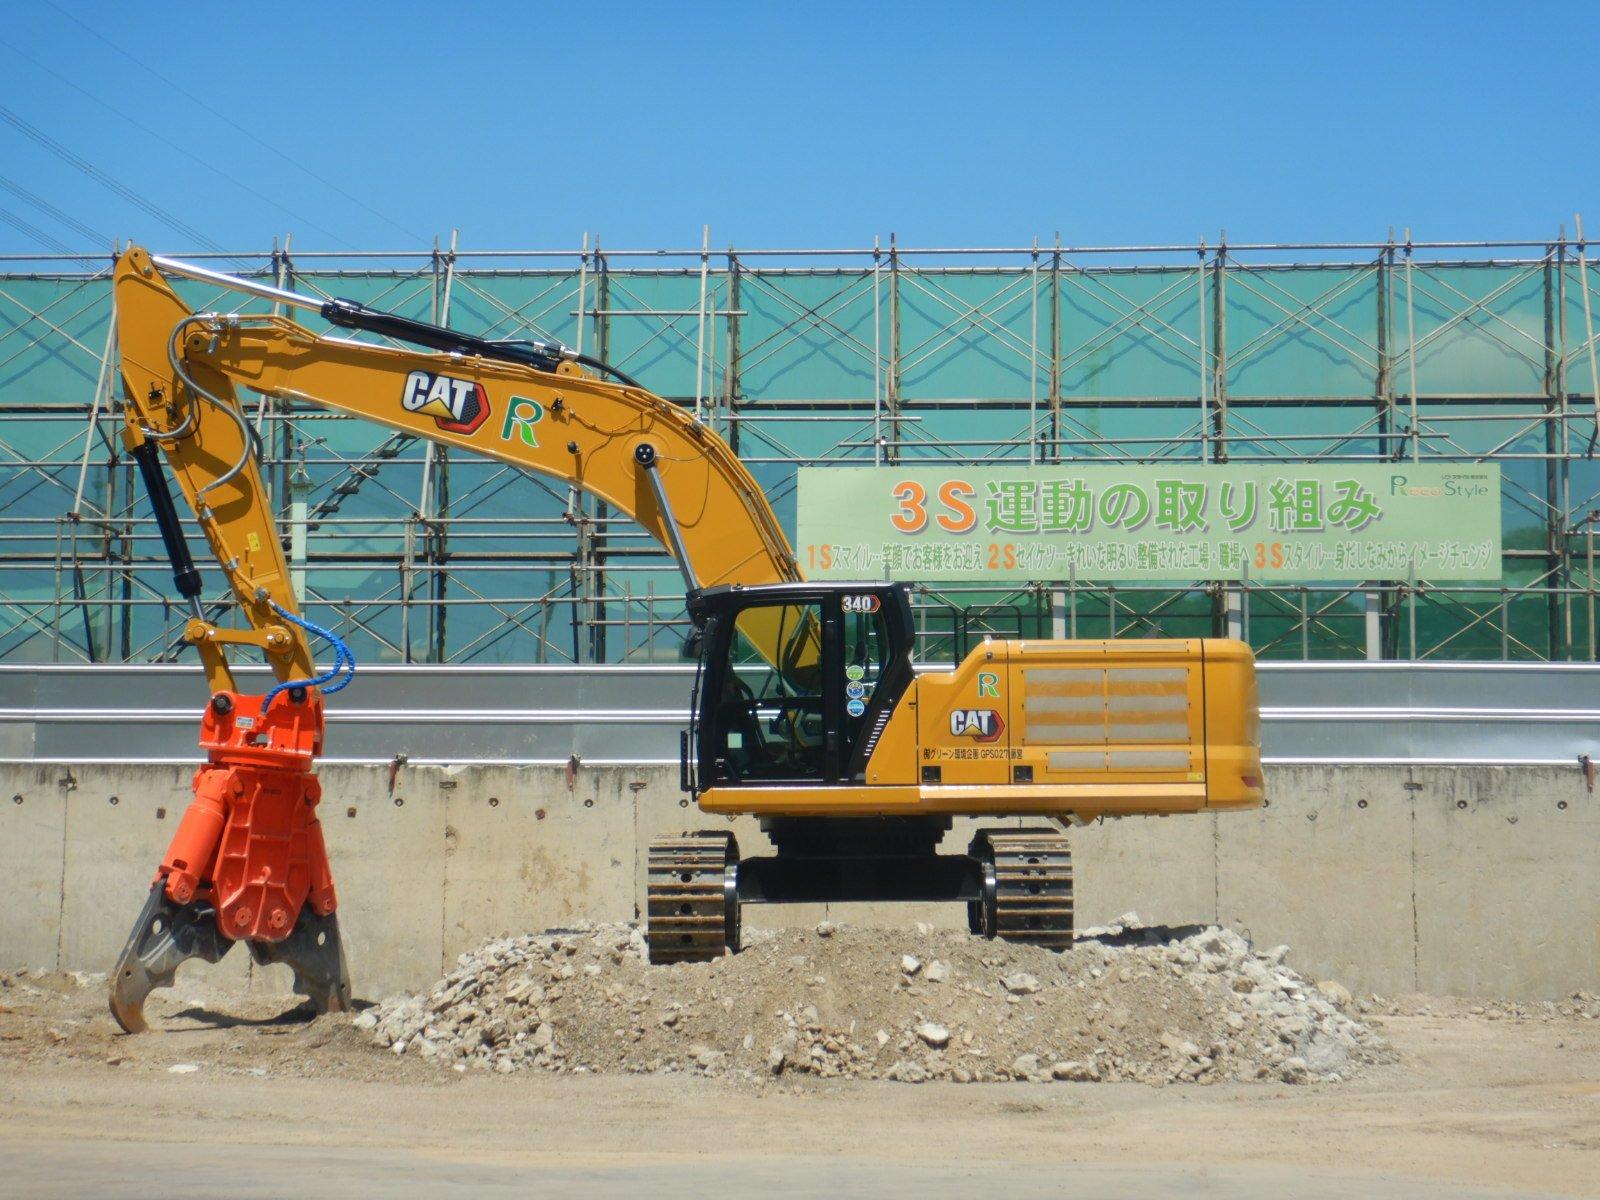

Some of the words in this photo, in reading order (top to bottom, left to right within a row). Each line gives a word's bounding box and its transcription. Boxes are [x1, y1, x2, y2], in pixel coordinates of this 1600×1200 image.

[403, 371, 474, 421] CAT
[1444, 480, 1489, 498] Style
[889, 479, 1381, 533] 3S運動の取り組み
[843, 596, 871, 612] 340
[950, 710, 992, 736] CAT
